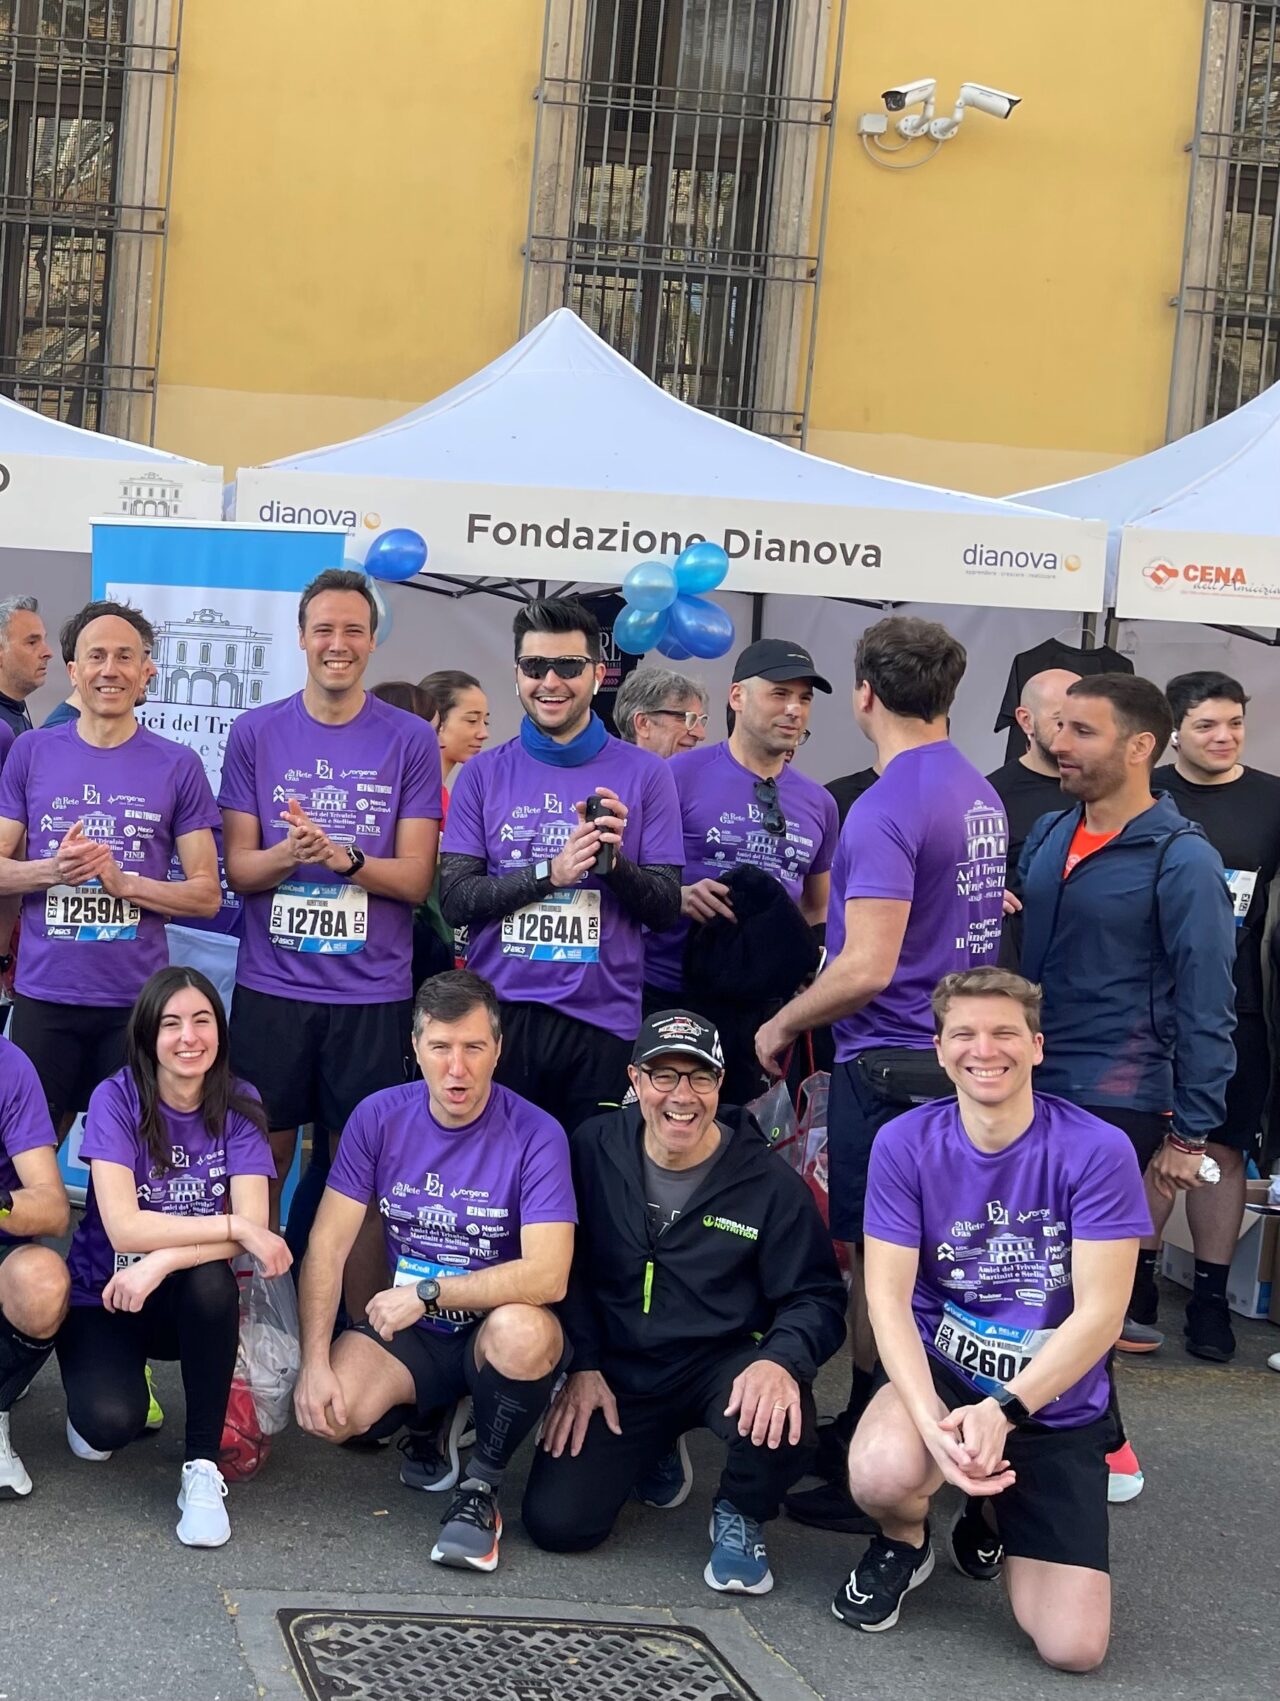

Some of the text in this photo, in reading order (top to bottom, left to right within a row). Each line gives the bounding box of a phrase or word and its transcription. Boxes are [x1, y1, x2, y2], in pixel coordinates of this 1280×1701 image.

[259, 501, 356, 528] dianova
[467, 513, 882, 568] Fondazione Dianova
[963, 544, 1057, 570] dianova
[1184, 564, 1246, 584] CENA
[134, 711, 165, 729] ici
[172, 714, 199, 732] del
[356, 826, 381, 834] FINER
[62, 897, 124, 923] 1259A
[287, 907, 348, 937] 1278A
[518, 913, 583, 944] 1264A
